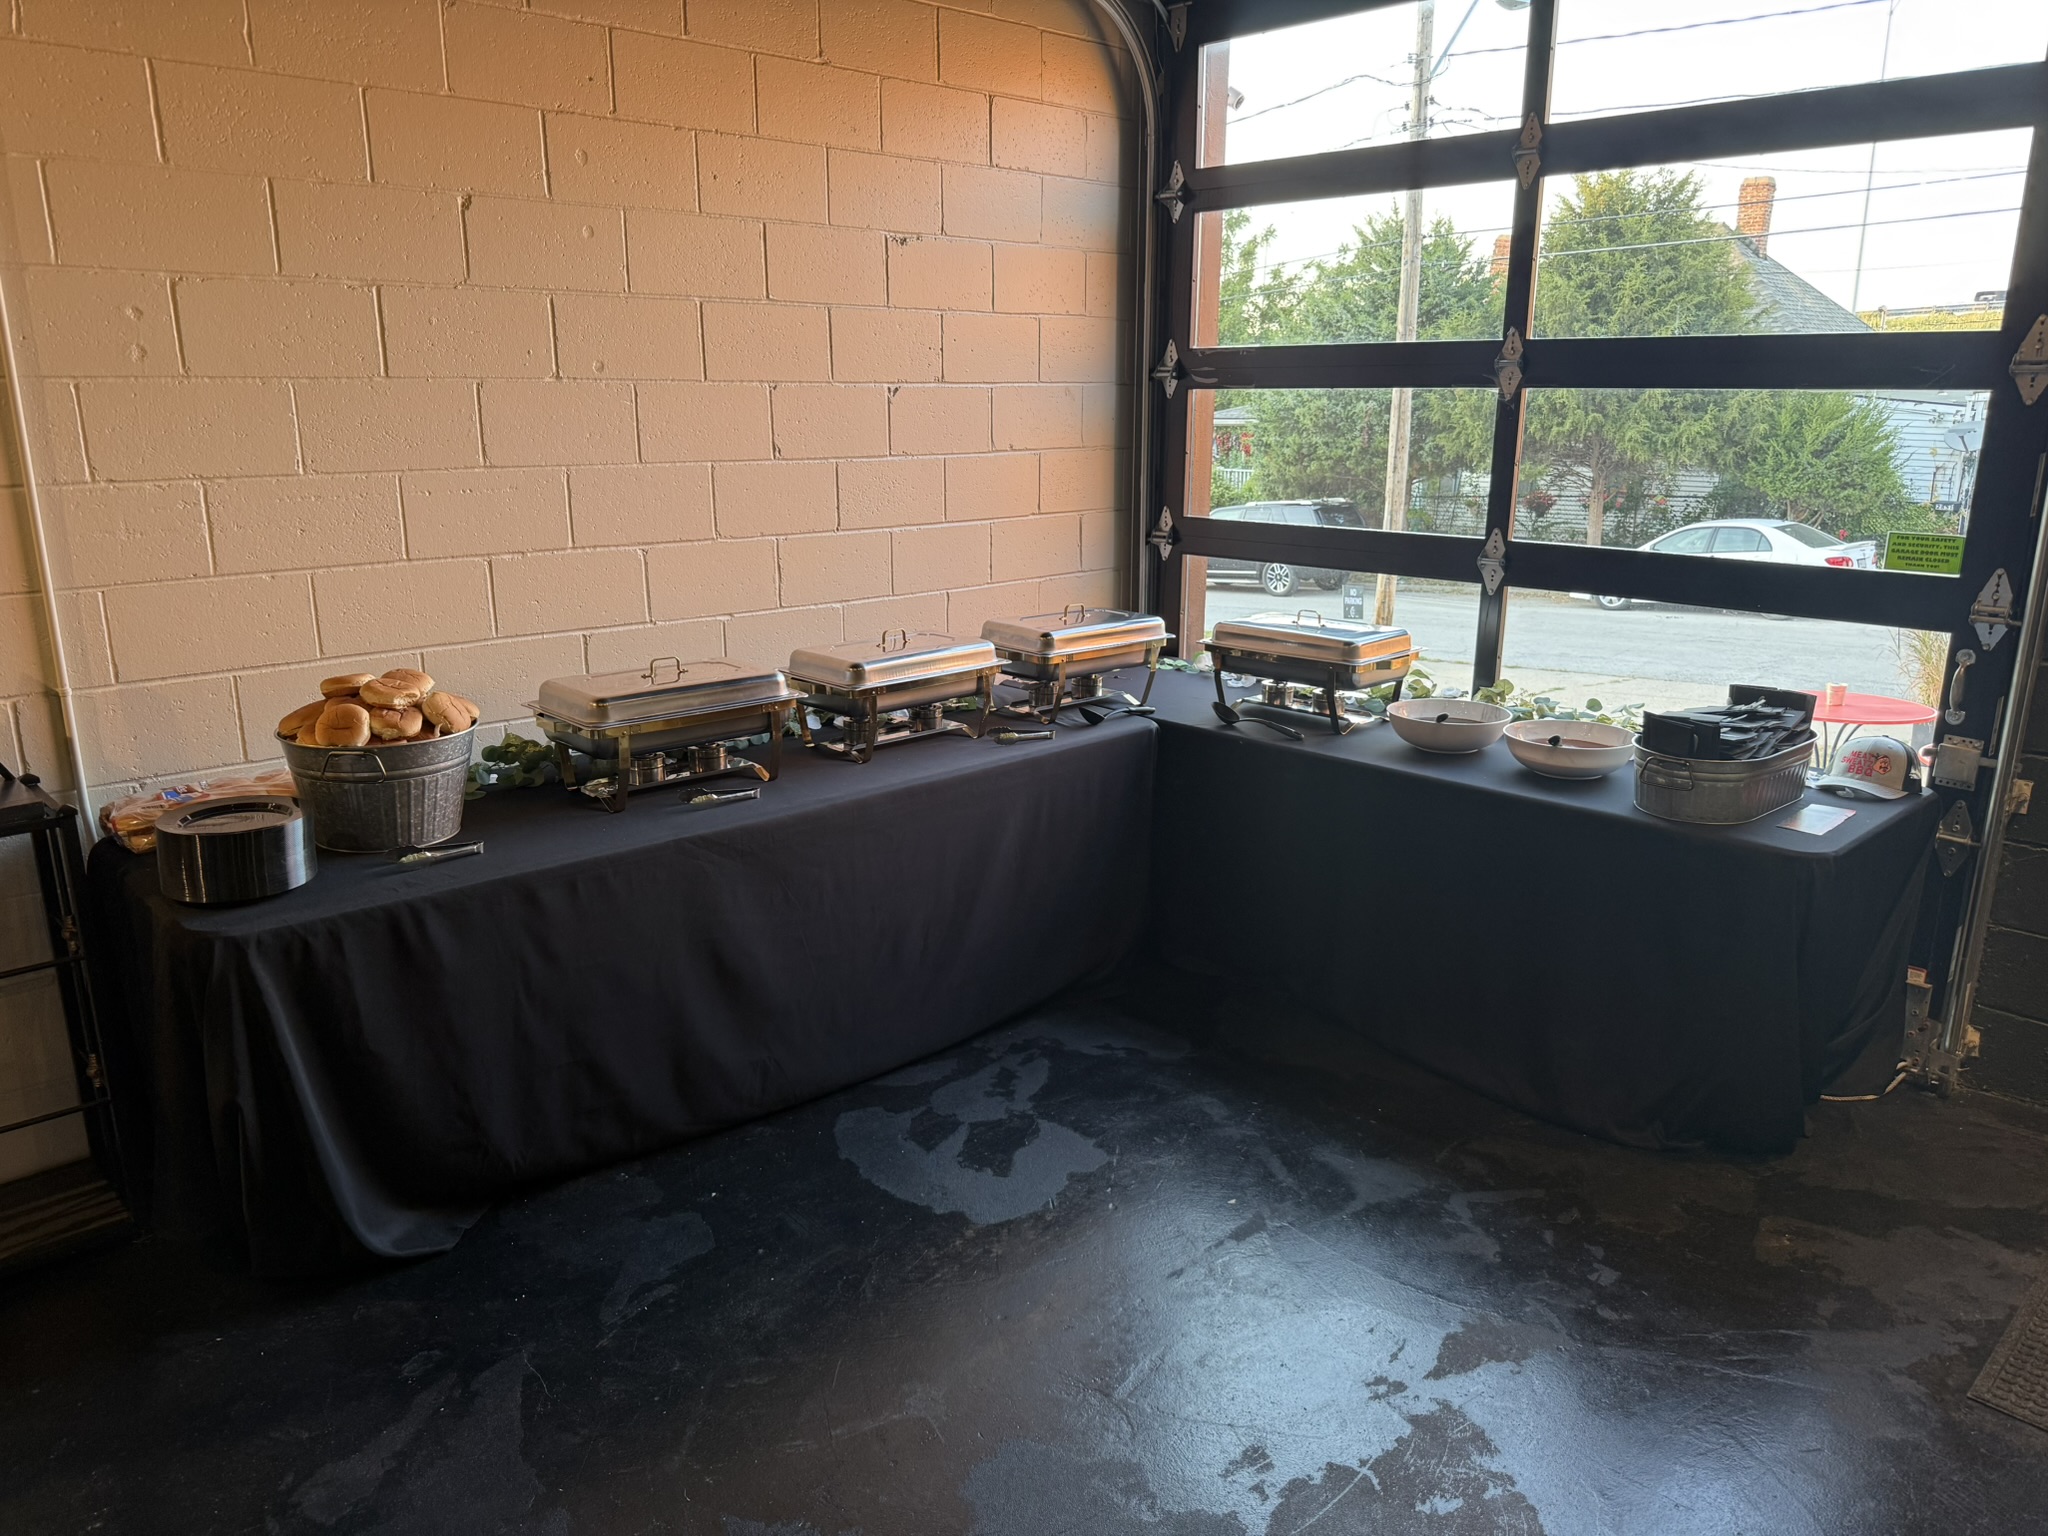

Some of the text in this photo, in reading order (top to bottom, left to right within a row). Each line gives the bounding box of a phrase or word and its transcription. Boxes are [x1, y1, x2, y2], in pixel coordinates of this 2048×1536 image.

[1349, 588, 1357, 596] NO
[1344, 597, 1362, 605] PARKING
[1851, 750, 1873, 760] MEAT
[1841, 756, 1874, 767] SWEATZ
[1847, 765, 1873, 777] BBQ
